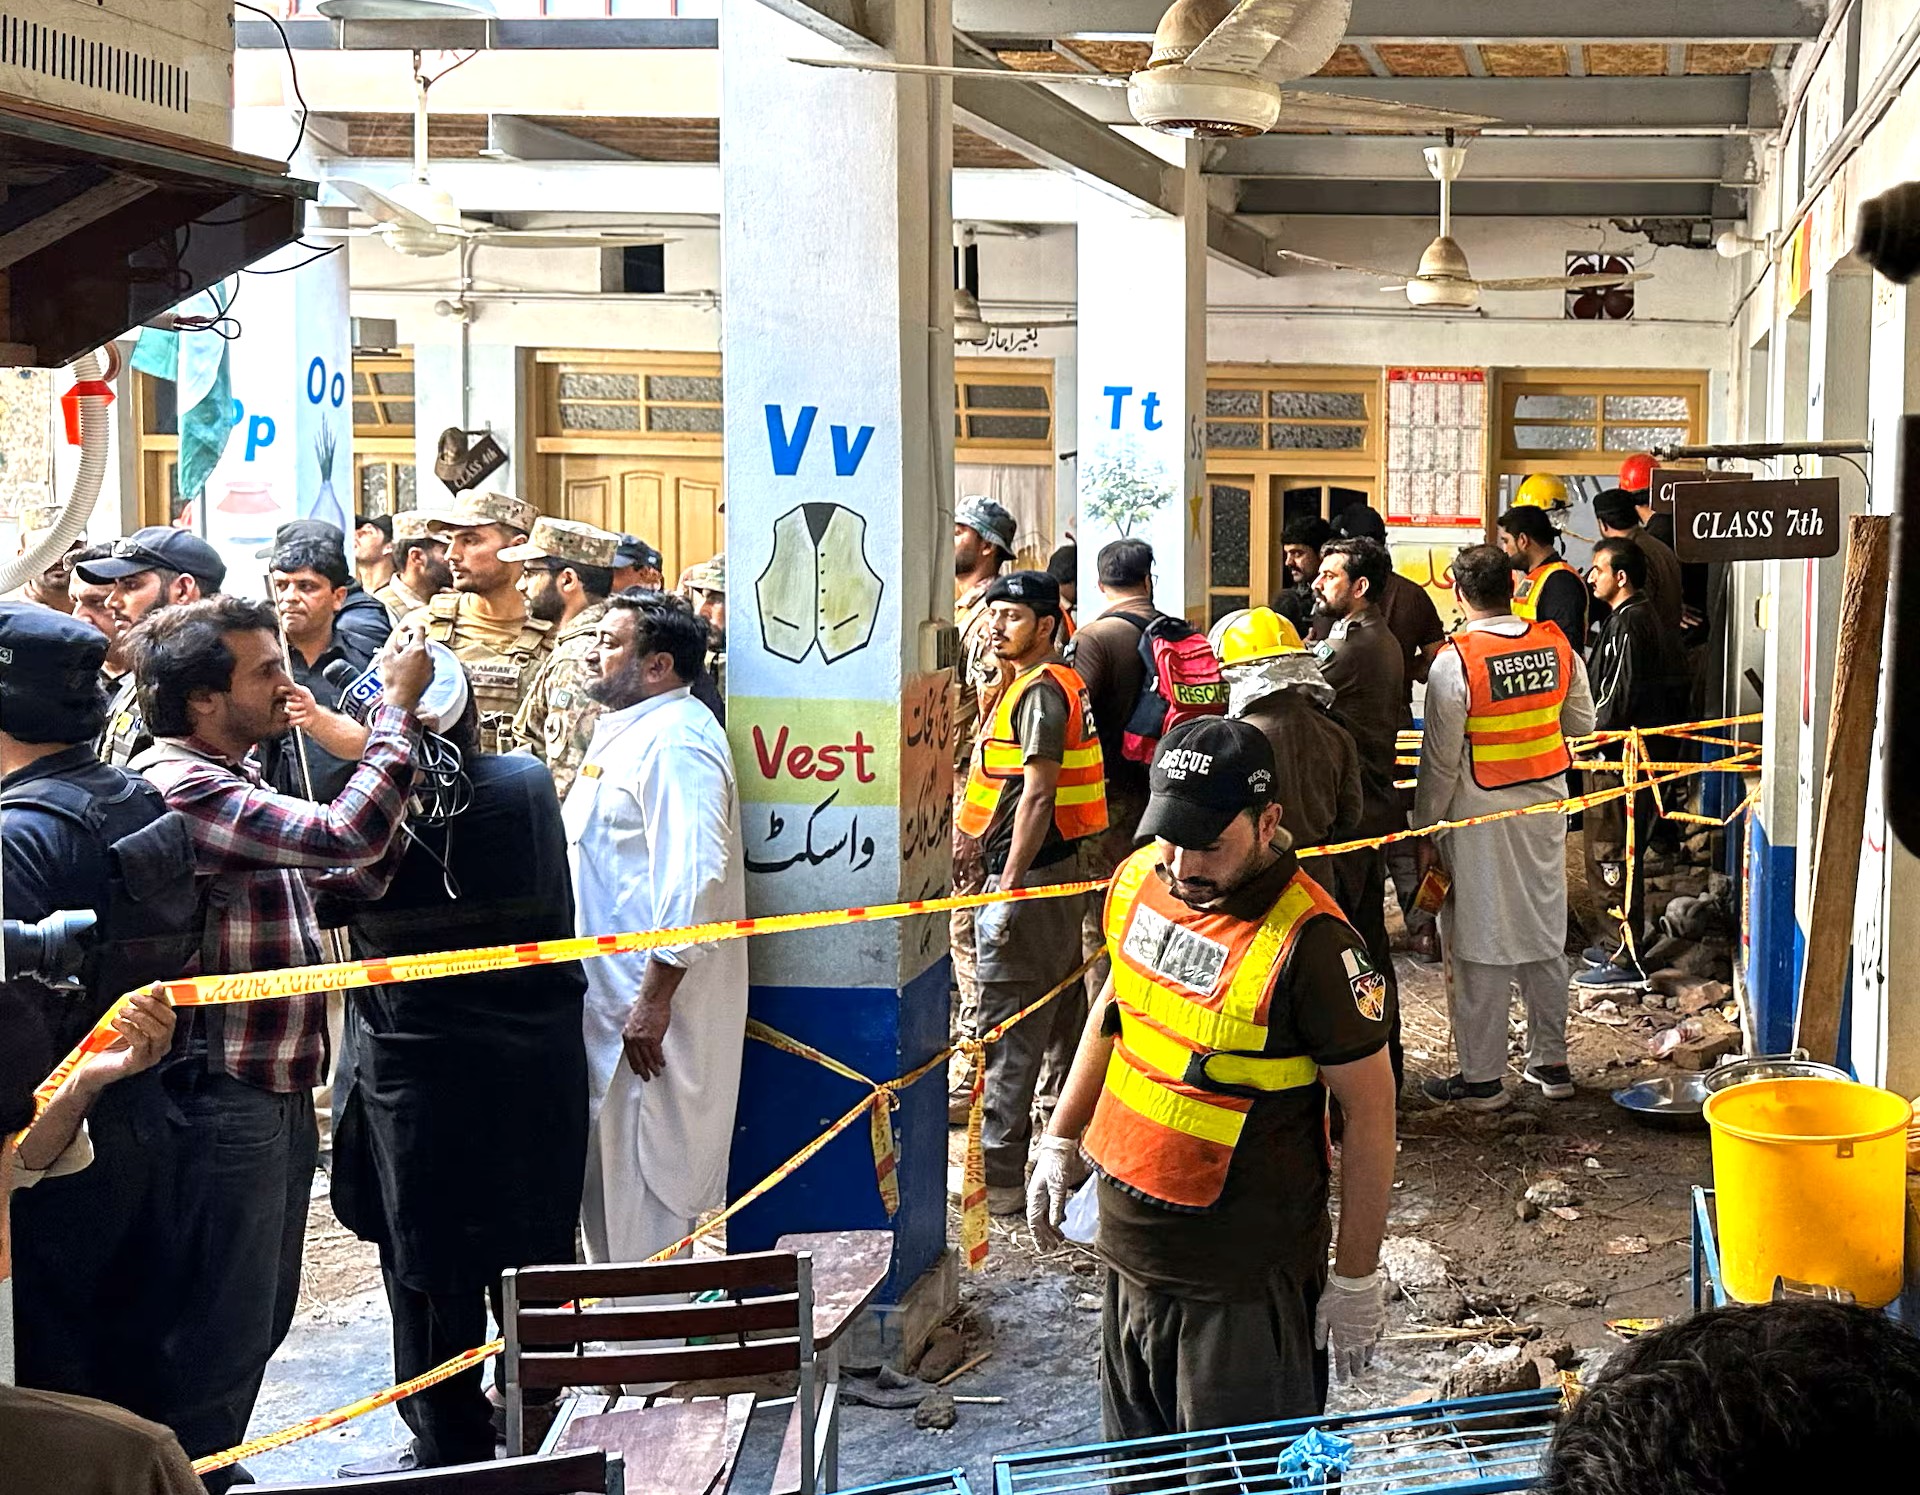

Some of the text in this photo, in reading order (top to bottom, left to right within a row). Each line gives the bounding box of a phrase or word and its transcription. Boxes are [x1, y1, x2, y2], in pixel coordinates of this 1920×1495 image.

[1416, 371, 1456, 381] TABLES
[453, 459, 484, 488] CLASS
[1692, 507, 1825, 540] CLASS 7th
[1493, 650, 1556, 676] RESCUE
[1503, 668, 1554, 695] 1122
[752, 724, 876, 784] Vest
[1166, 767, 1187, 780] 1122
[743, 788, 875, 874] واسکٹ
